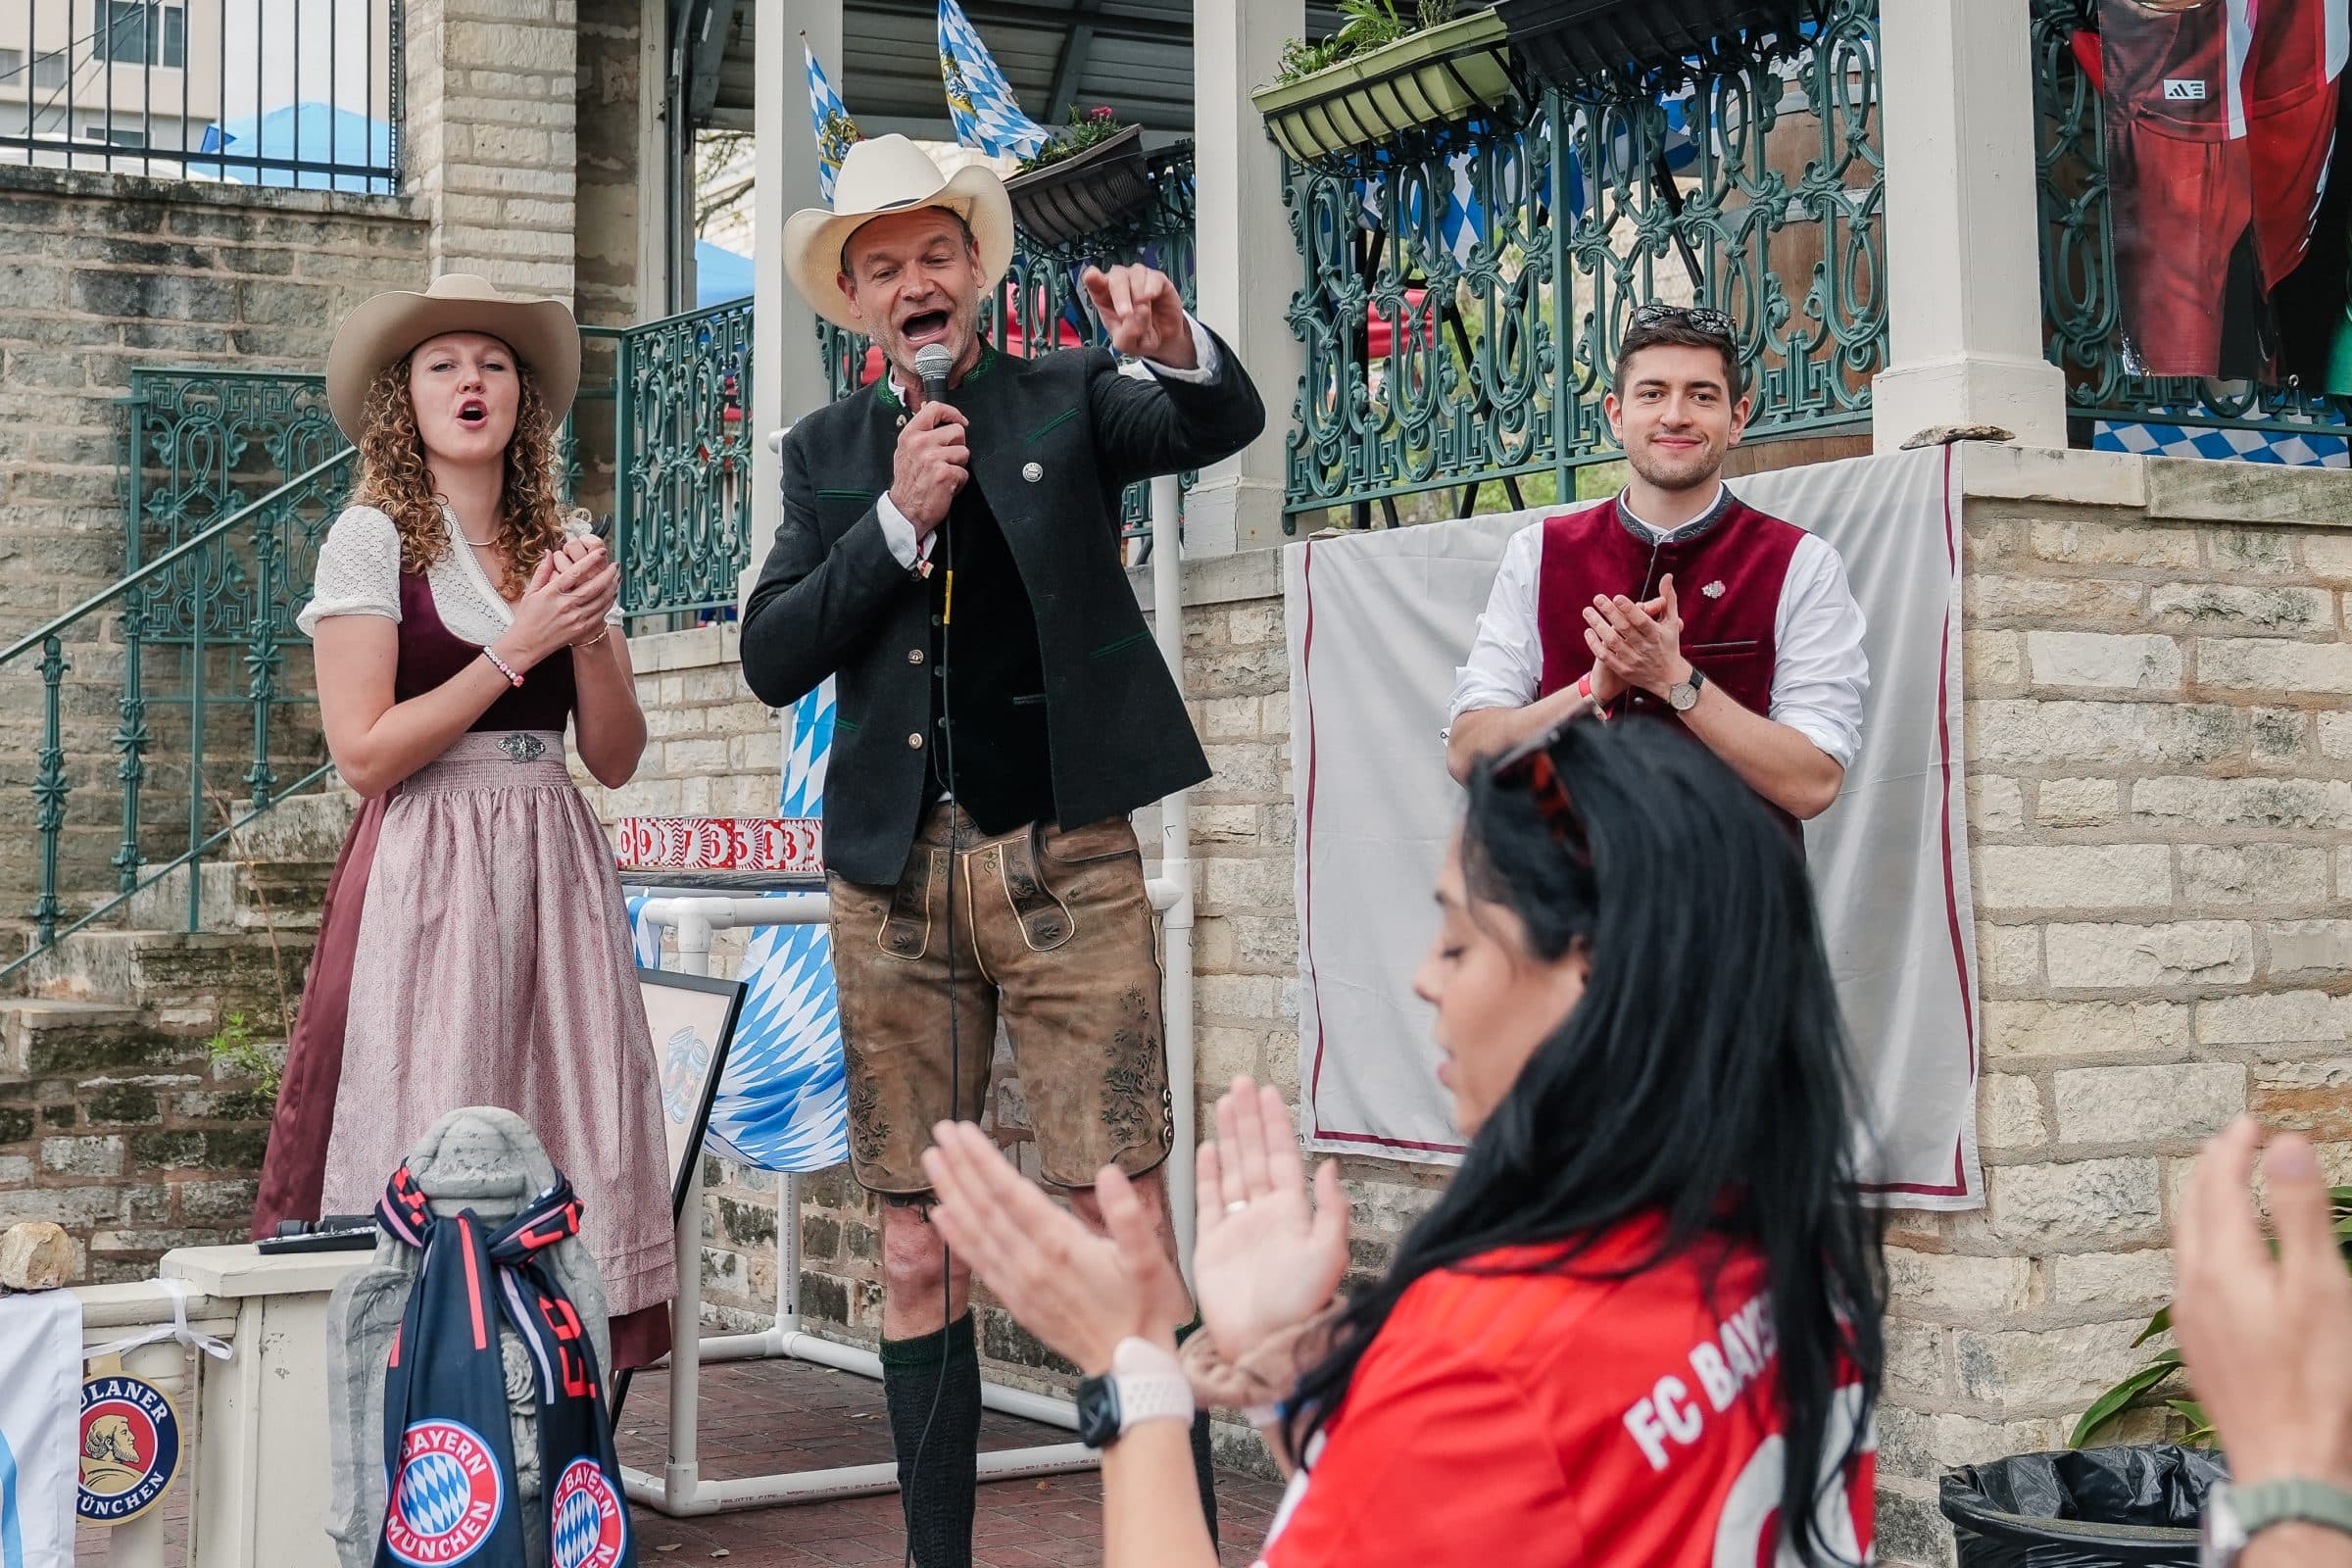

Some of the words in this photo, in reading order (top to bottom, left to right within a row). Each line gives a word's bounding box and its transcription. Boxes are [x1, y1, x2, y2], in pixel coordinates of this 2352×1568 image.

[710, 830, 720, 858] 6
[735, 831, 747, 859] 5
[1622, 1375, 1703, 1471] FC
[402, 1430, 488, 1476] BAYERN
[77, 1471, 165, 1515] ÜNCHEN
[564, 1466, 615, 1519] BAYERN
